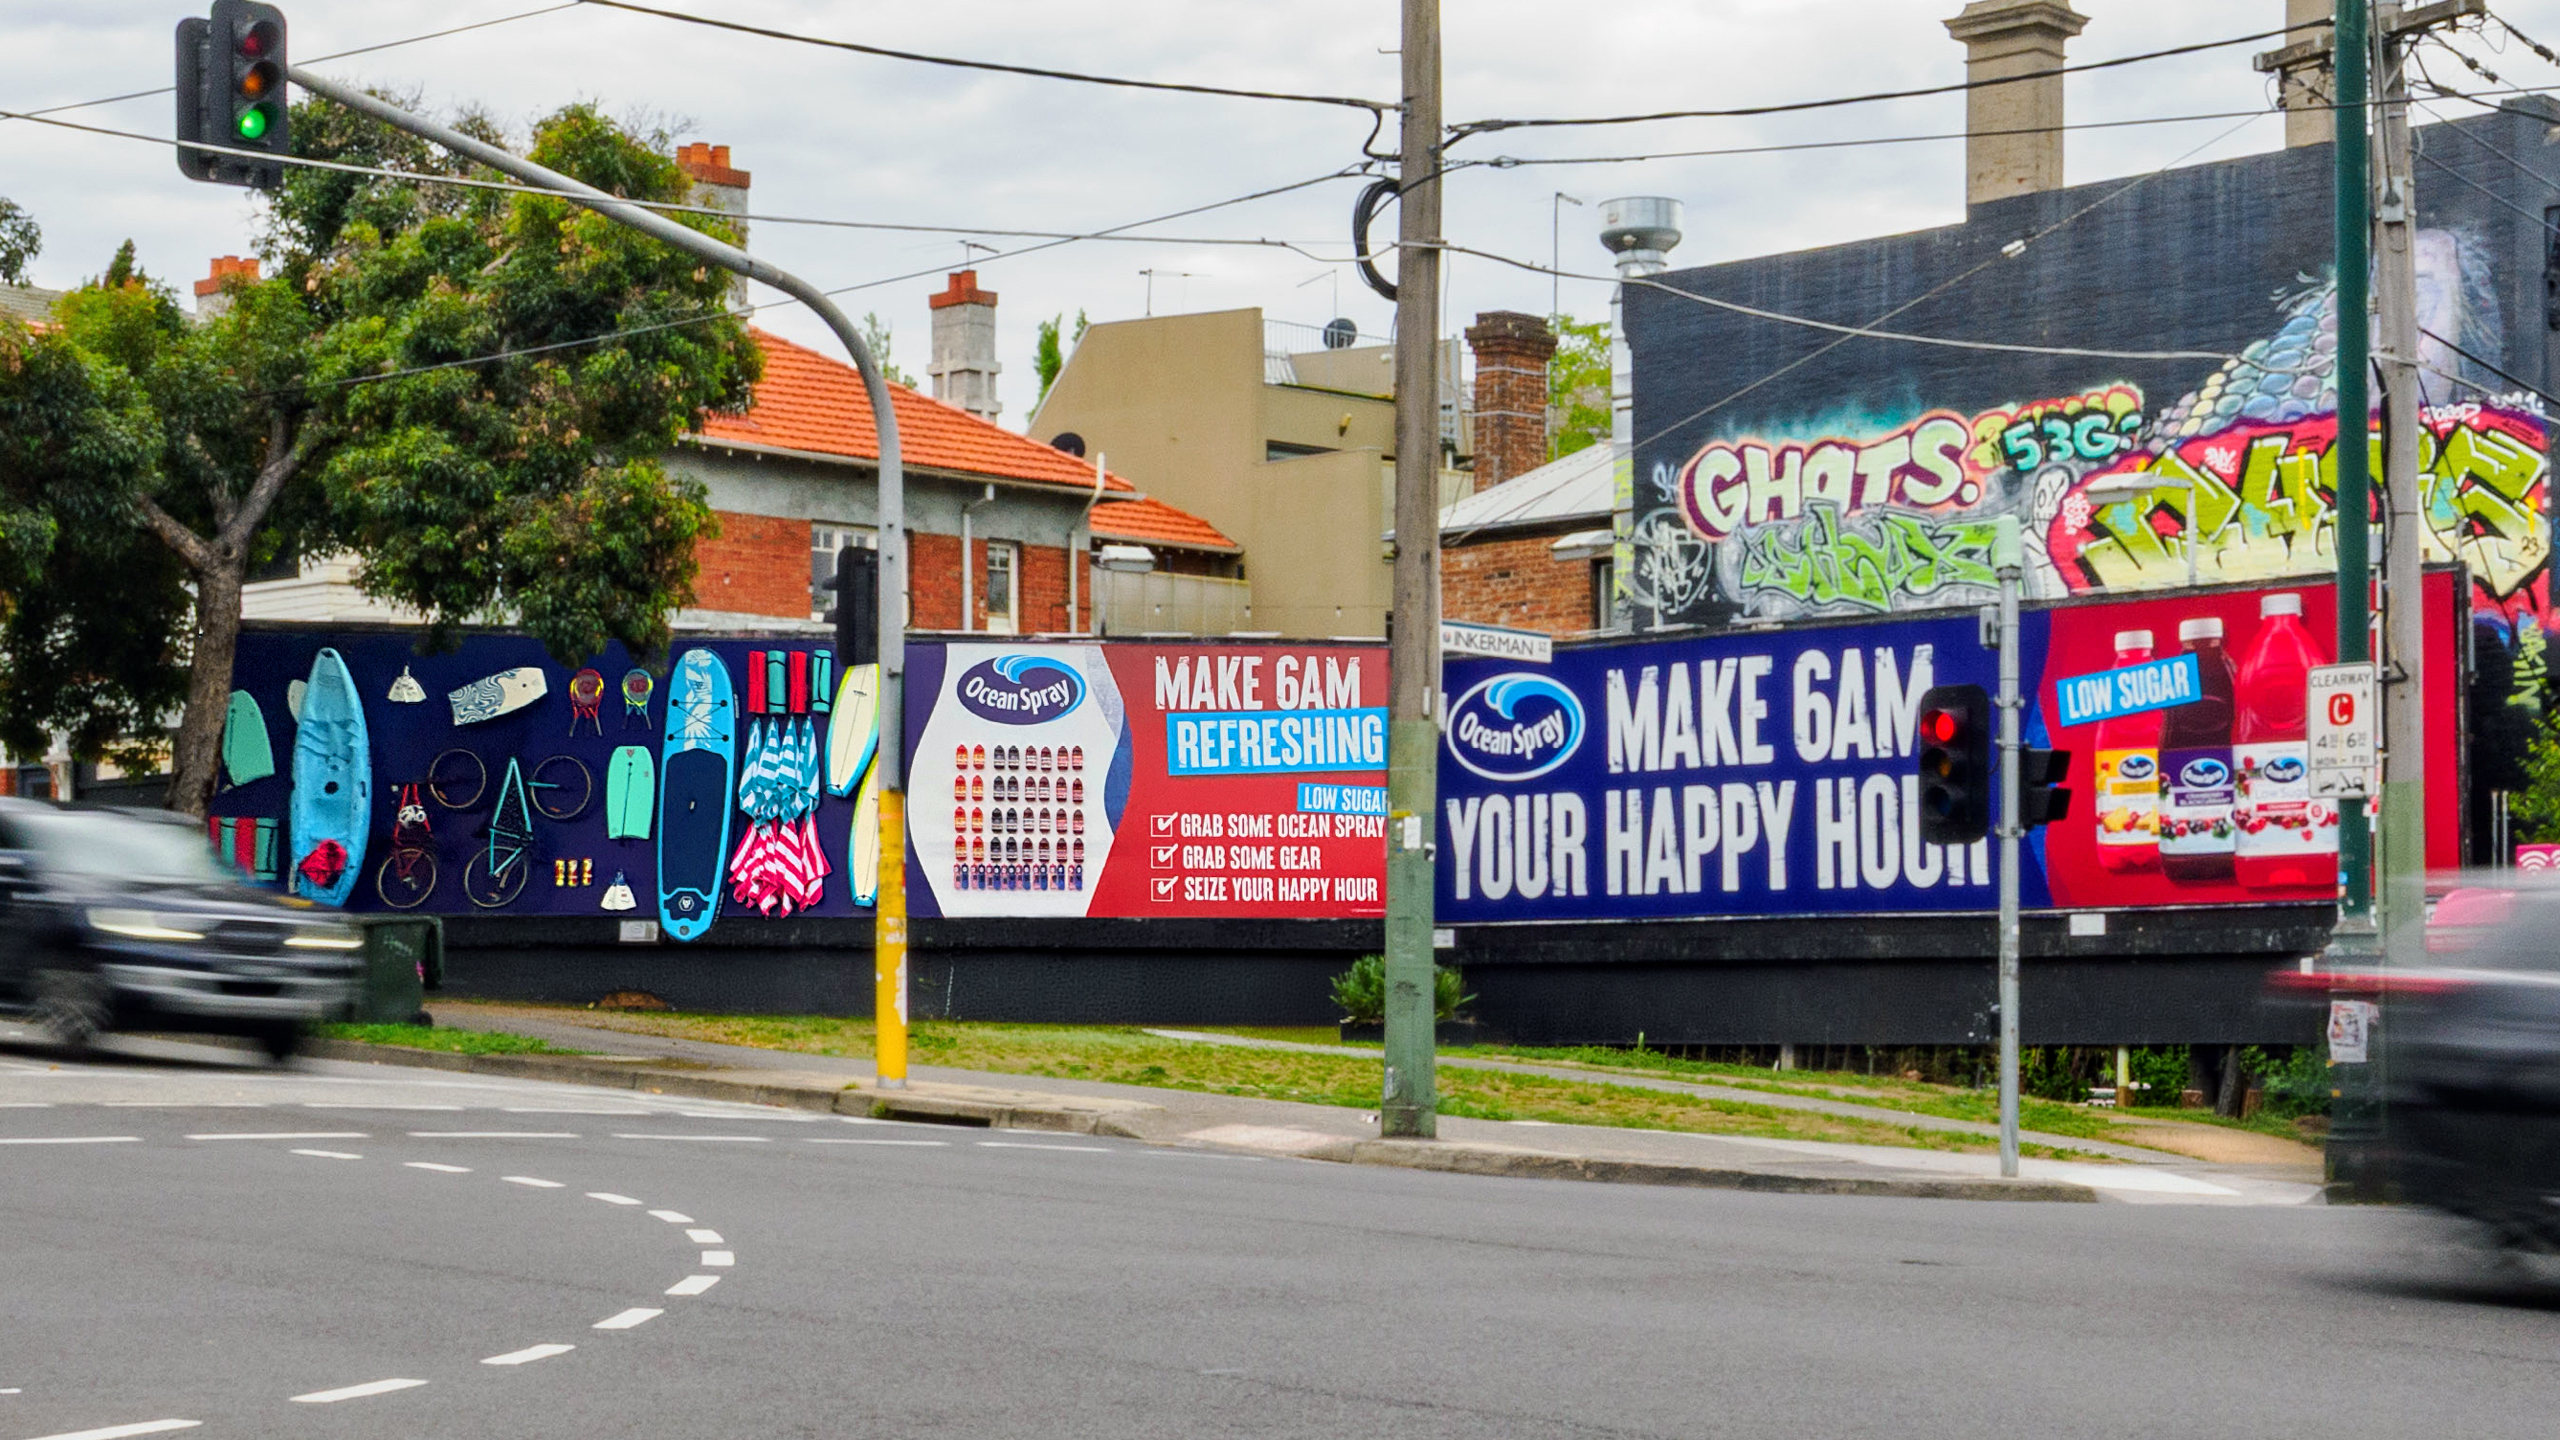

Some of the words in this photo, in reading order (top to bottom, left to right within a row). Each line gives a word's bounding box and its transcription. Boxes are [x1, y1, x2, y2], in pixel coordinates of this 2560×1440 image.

[1454, 630, 1534, 656] INKERMAN
[965, 676, 1018, 711] Ocean
[1019, 679, 1070, 715] Spray
[1155, 655, 1264, 711] MAKE
[1275, 654, 1361, 711] 6AM
[2066, 675, 2113, 720] LOW
[2117, 660, 2191, 710] SUGAR
[2310, 672, 2371, 688] CLEARWAY
[1606, 654, 1775, 774] MAKE
[1793, 643, 1934, 763] 6AM
[1177, 714, 1385, 769] REFRESHING
[1458, 711, 1512, 756] Ocean
[1513, 708, 1565, 760] Spray
[1304, 786, 1338, 811] LOW
[1180, 813, 1224, 838] GRAB
[1228, 814, 1274, 838] SOME
[1278, 814, 1331, 838] OCEAN
[1335, 814, 1386, 838] SPRAY
[1446, 791, 1589, 900] YOUR
[1606, 779, 1797, 896] HAPPY
[1182, 845, 1226, 870] GRAB
[1230, 846, 1276, 870] SOME
[1280, 846, 1322, 870] GEAR
[1184, 876, 1228, 901] SEIZE
[1232, 877, 1274, 901] YOUR
[1278, 878, 1331, 902] HAPPY
[1335, 878, 1379, 902] HOUR
